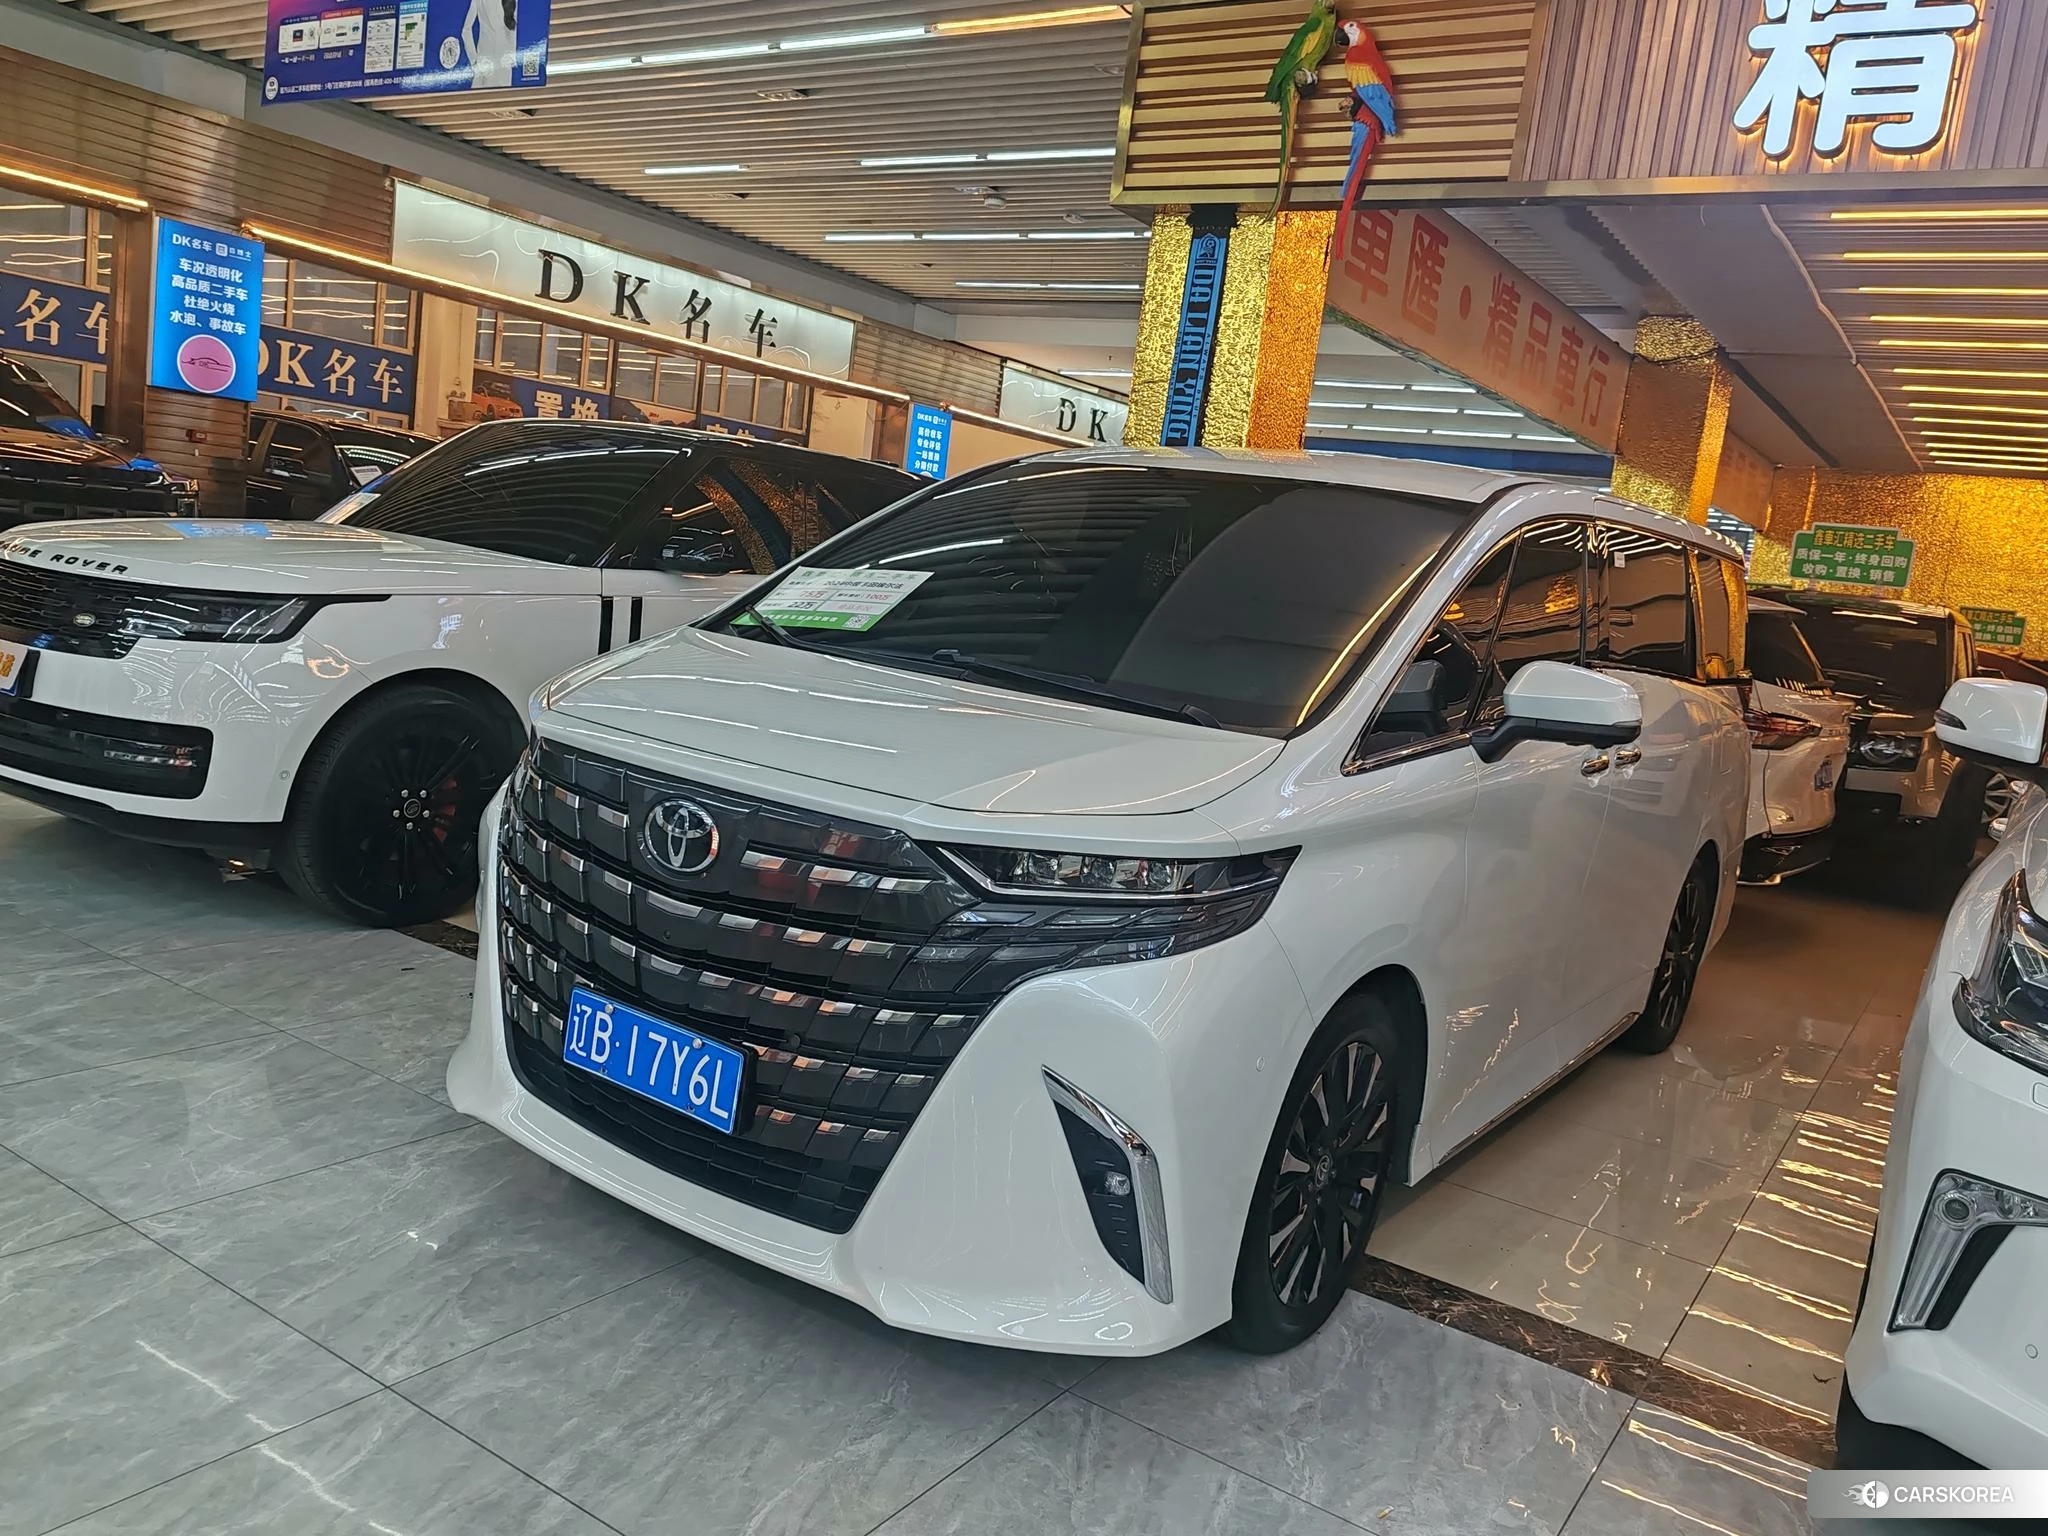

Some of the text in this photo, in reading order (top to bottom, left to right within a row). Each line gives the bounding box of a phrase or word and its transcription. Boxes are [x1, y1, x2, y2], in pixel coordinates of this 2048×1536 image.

[1732, 0, 1979, 157] 精
[172, 233, 213, 252] DK名车
[179, 257, 243, 284] 车况透明化
[171, 274, 249, 301] 高品质二手车
[183, 294, 235, 317] 杜绝火烧
[0, 288, 109, 355] 名车
[169, 310, 247, 336] 水泡、事故车
[533, 390, 600, 421] 置换
[1056, 397, 1127, 444] DK
[0, 540, 128, 575] ANGE ROVER
